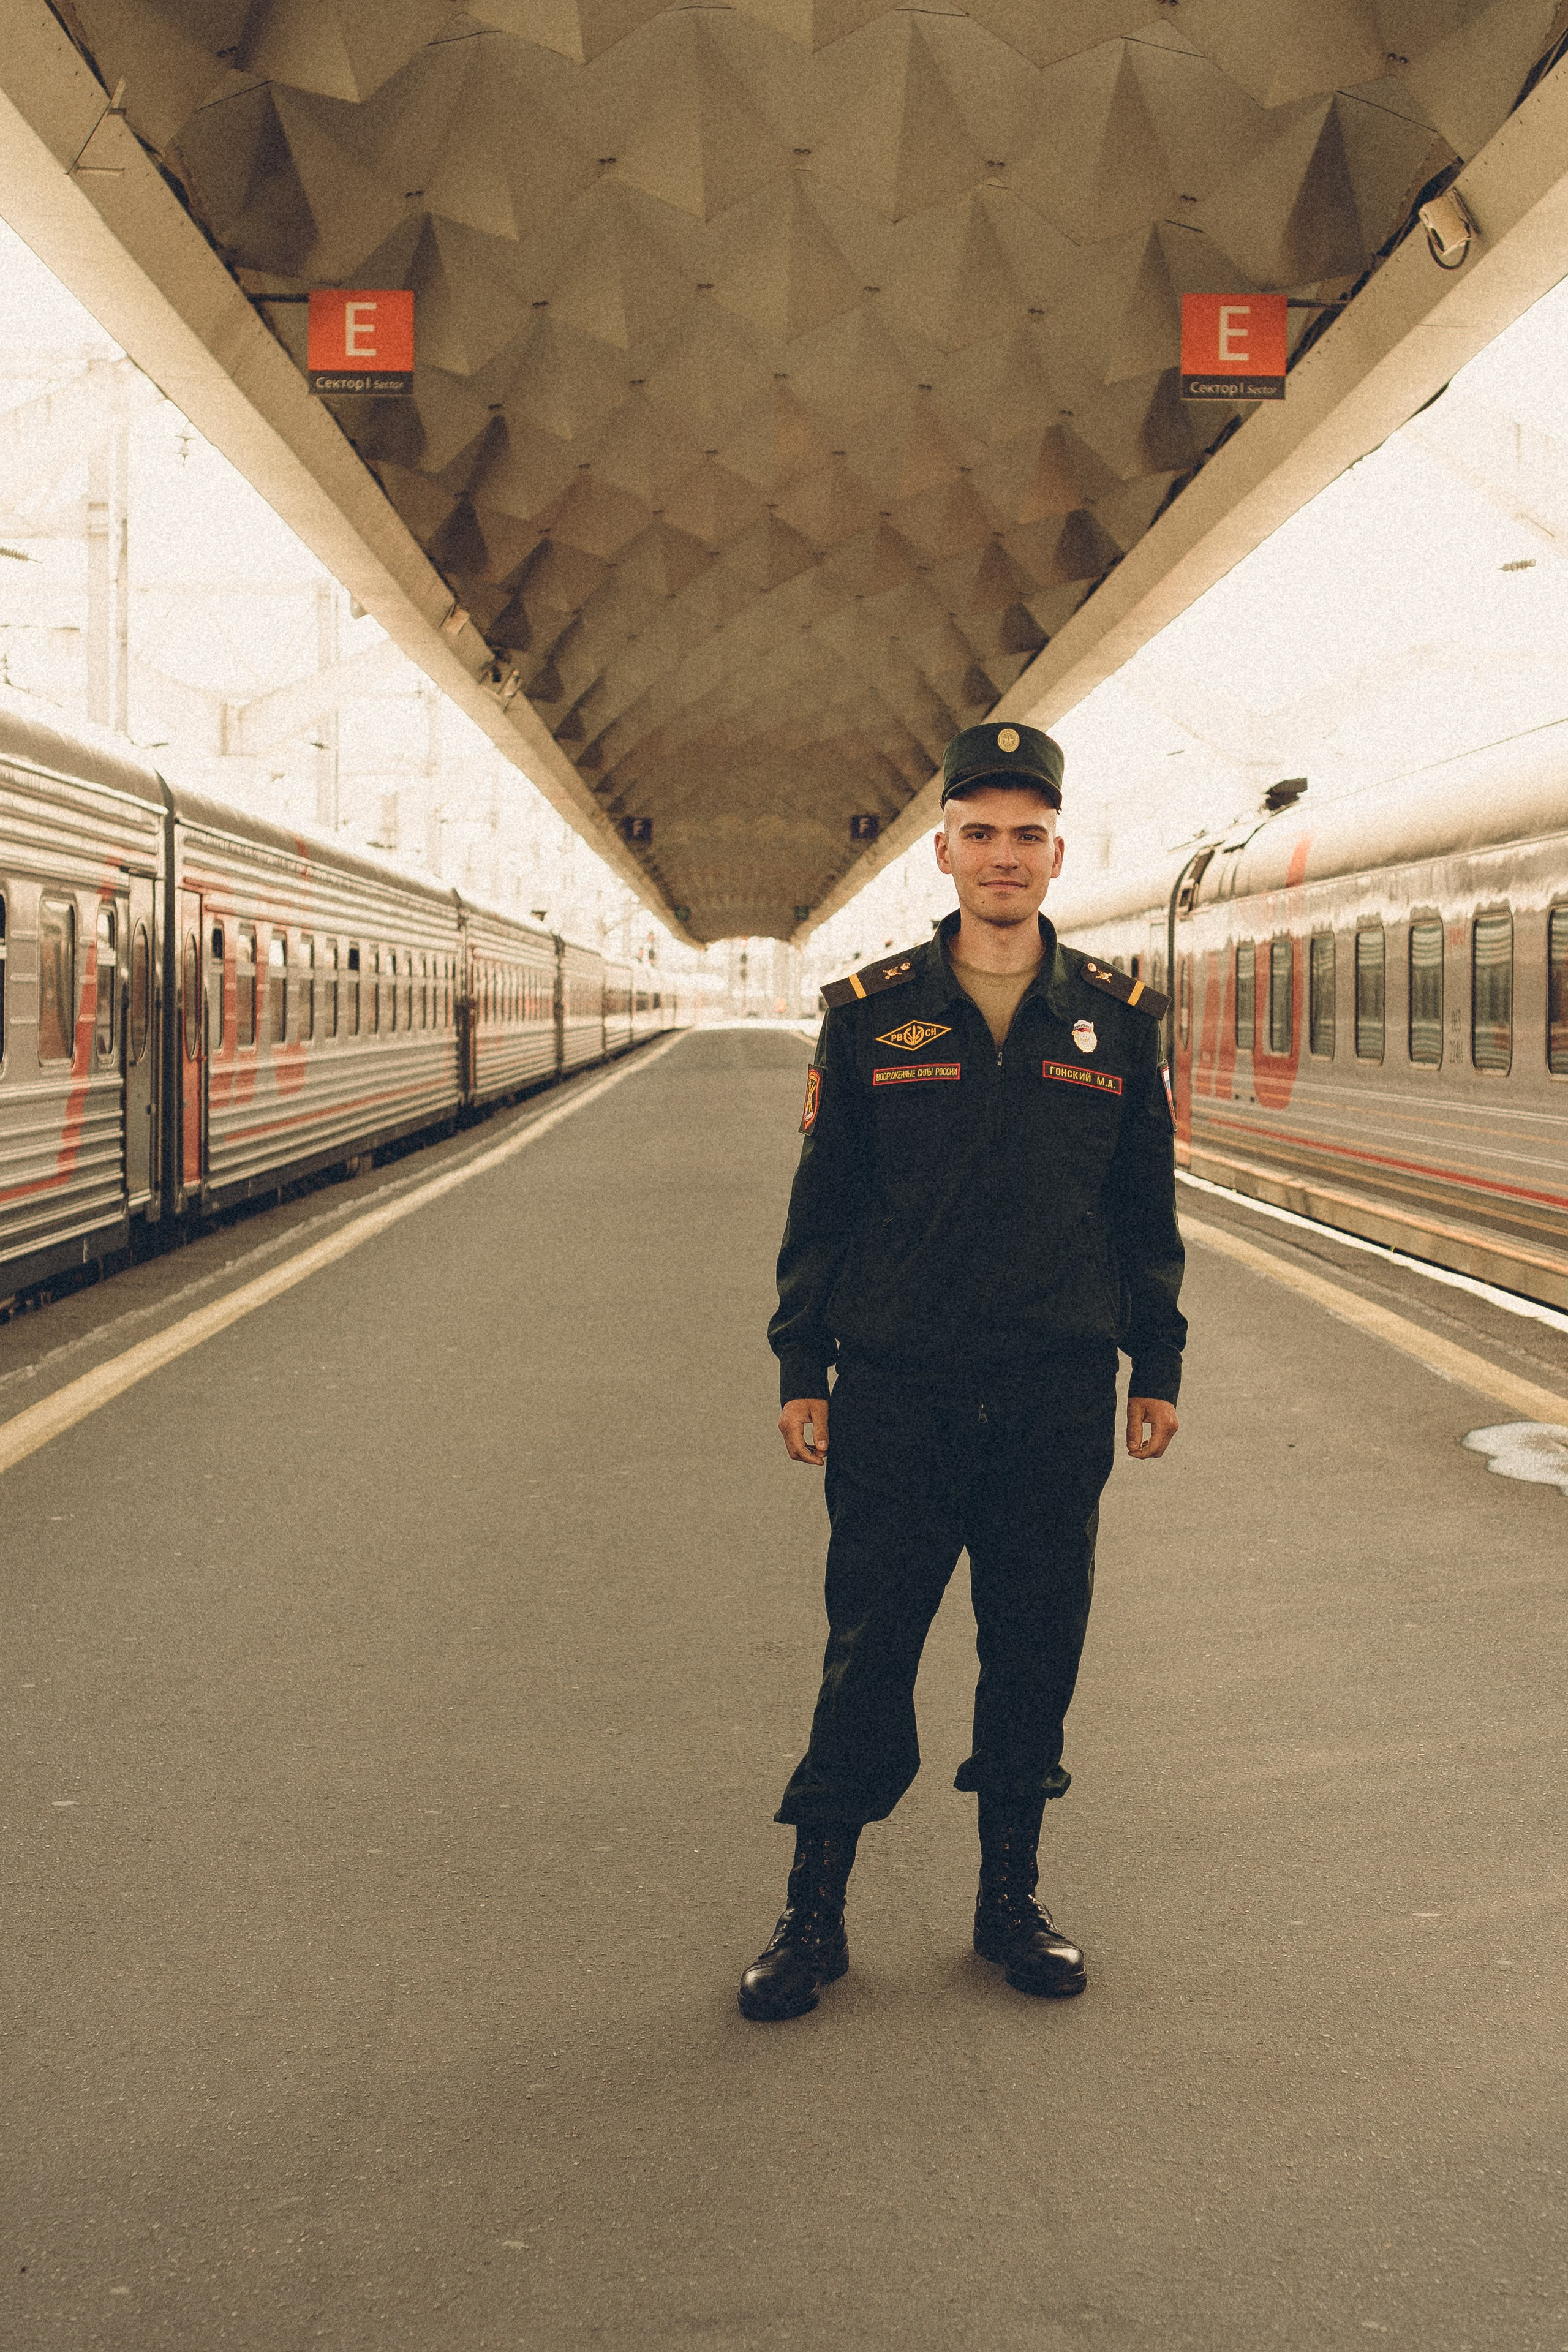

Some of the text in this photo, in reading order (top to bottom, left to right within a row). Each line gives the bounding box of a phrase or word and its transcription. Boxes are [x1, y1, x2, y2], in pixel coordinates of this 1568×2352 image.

[345, 301, 378, 357] E
[1219, 305, 1251, 361] E
[315, 376, 405, 392] Сектор Sector
[1189, 381, 1278, 396] Сектор Sector
[859, 818, 870, 834] F
[891, 1027, 937, 1042] РВ СН
[876, 1069, 916, 1082] ВООРУЖЕННЫЕ
[918, 1068, 933, 1077] СИЛЫ
[1050, 1066, 1116, 1089] ГОНСКИЙ М.А.
